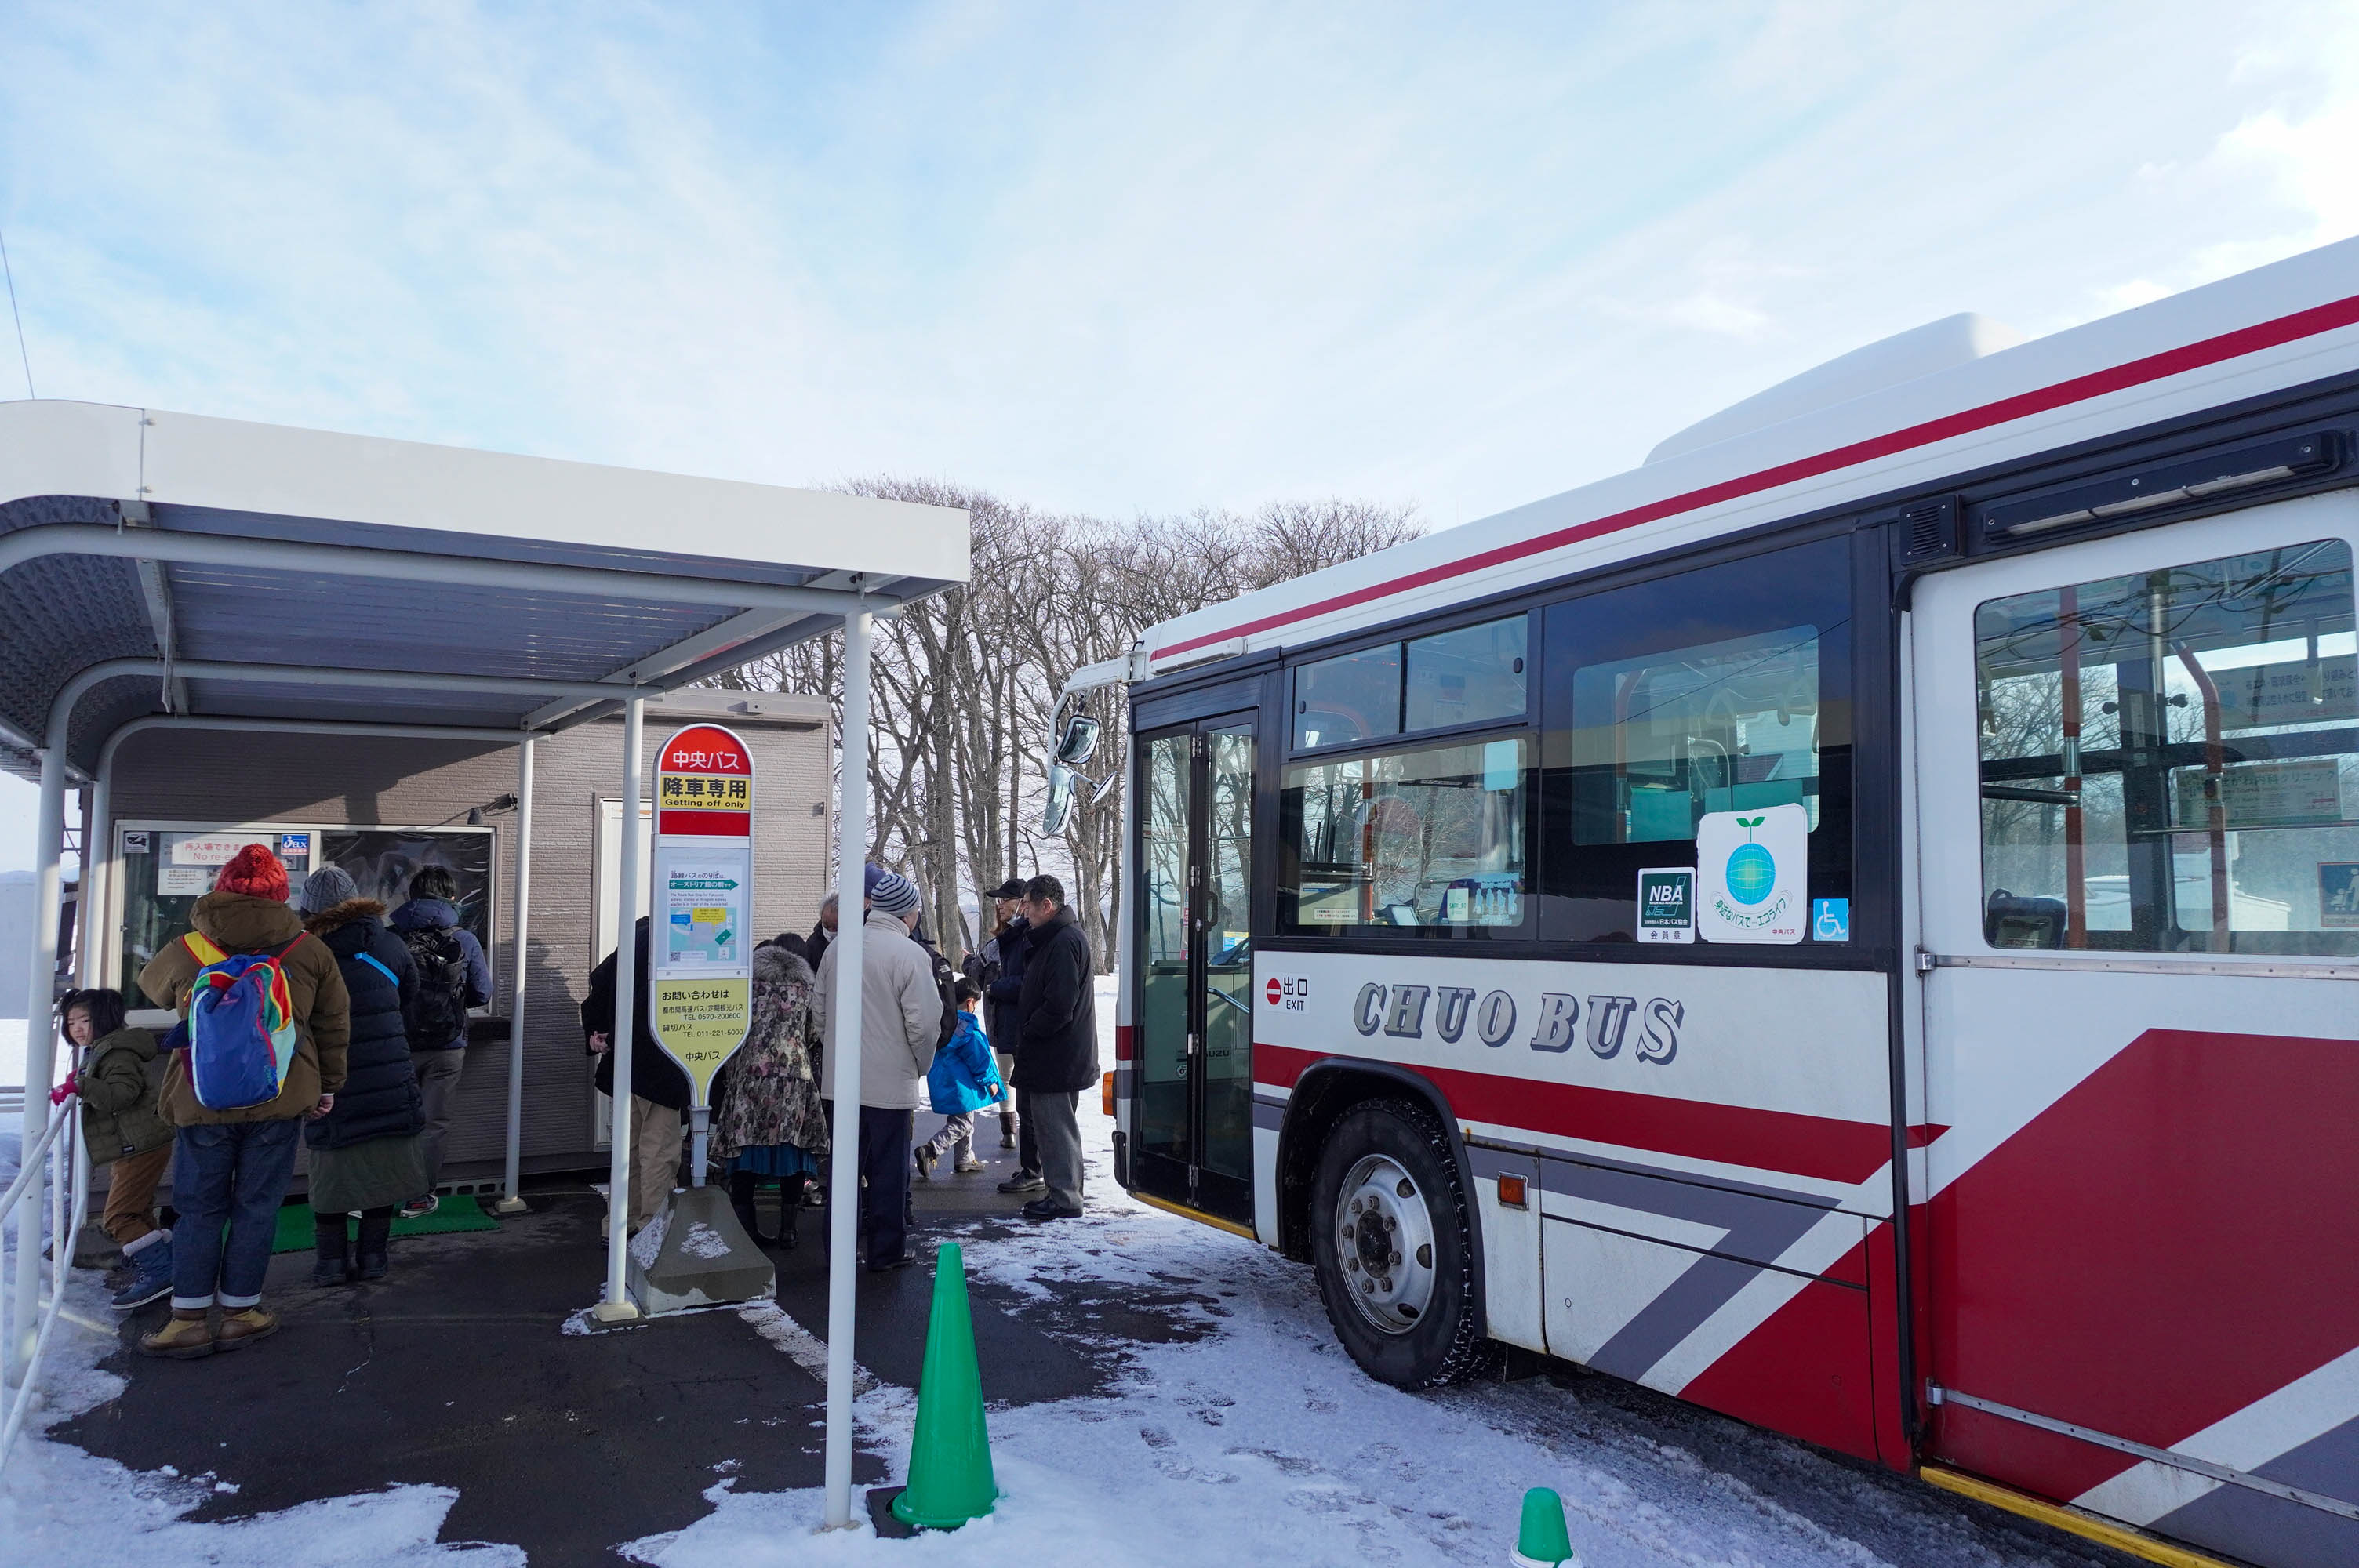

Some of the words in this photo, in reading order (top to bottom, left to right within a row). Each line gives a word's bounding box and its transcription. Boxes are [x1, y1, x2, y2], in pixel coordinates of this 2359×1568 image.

[673, 750, 740, 769] 中央バス
[663, 777, 747, 799] 降車専用
[665, 798, 703, 808] Getting
[185, 842, 242, 851] 再入場できま
[194, 852, 208, 861] No
[1649, 885, 1683, 902] NBA
[1284, 976, 1308, 996] 出口
[662, 989, 729, 1000] お問い合わせは
[1285, 1000, 1305, 1011] EXIT
[698, 1012, 741, 1021] 0570-200600
[1354, 982, 1516, 1048] CHUO
[1530, 992, 1685, 1066] BUS
[696, 1029, 743, 1037] 011-221-5000
[685, 1051, 721, 1062] 中央バス
